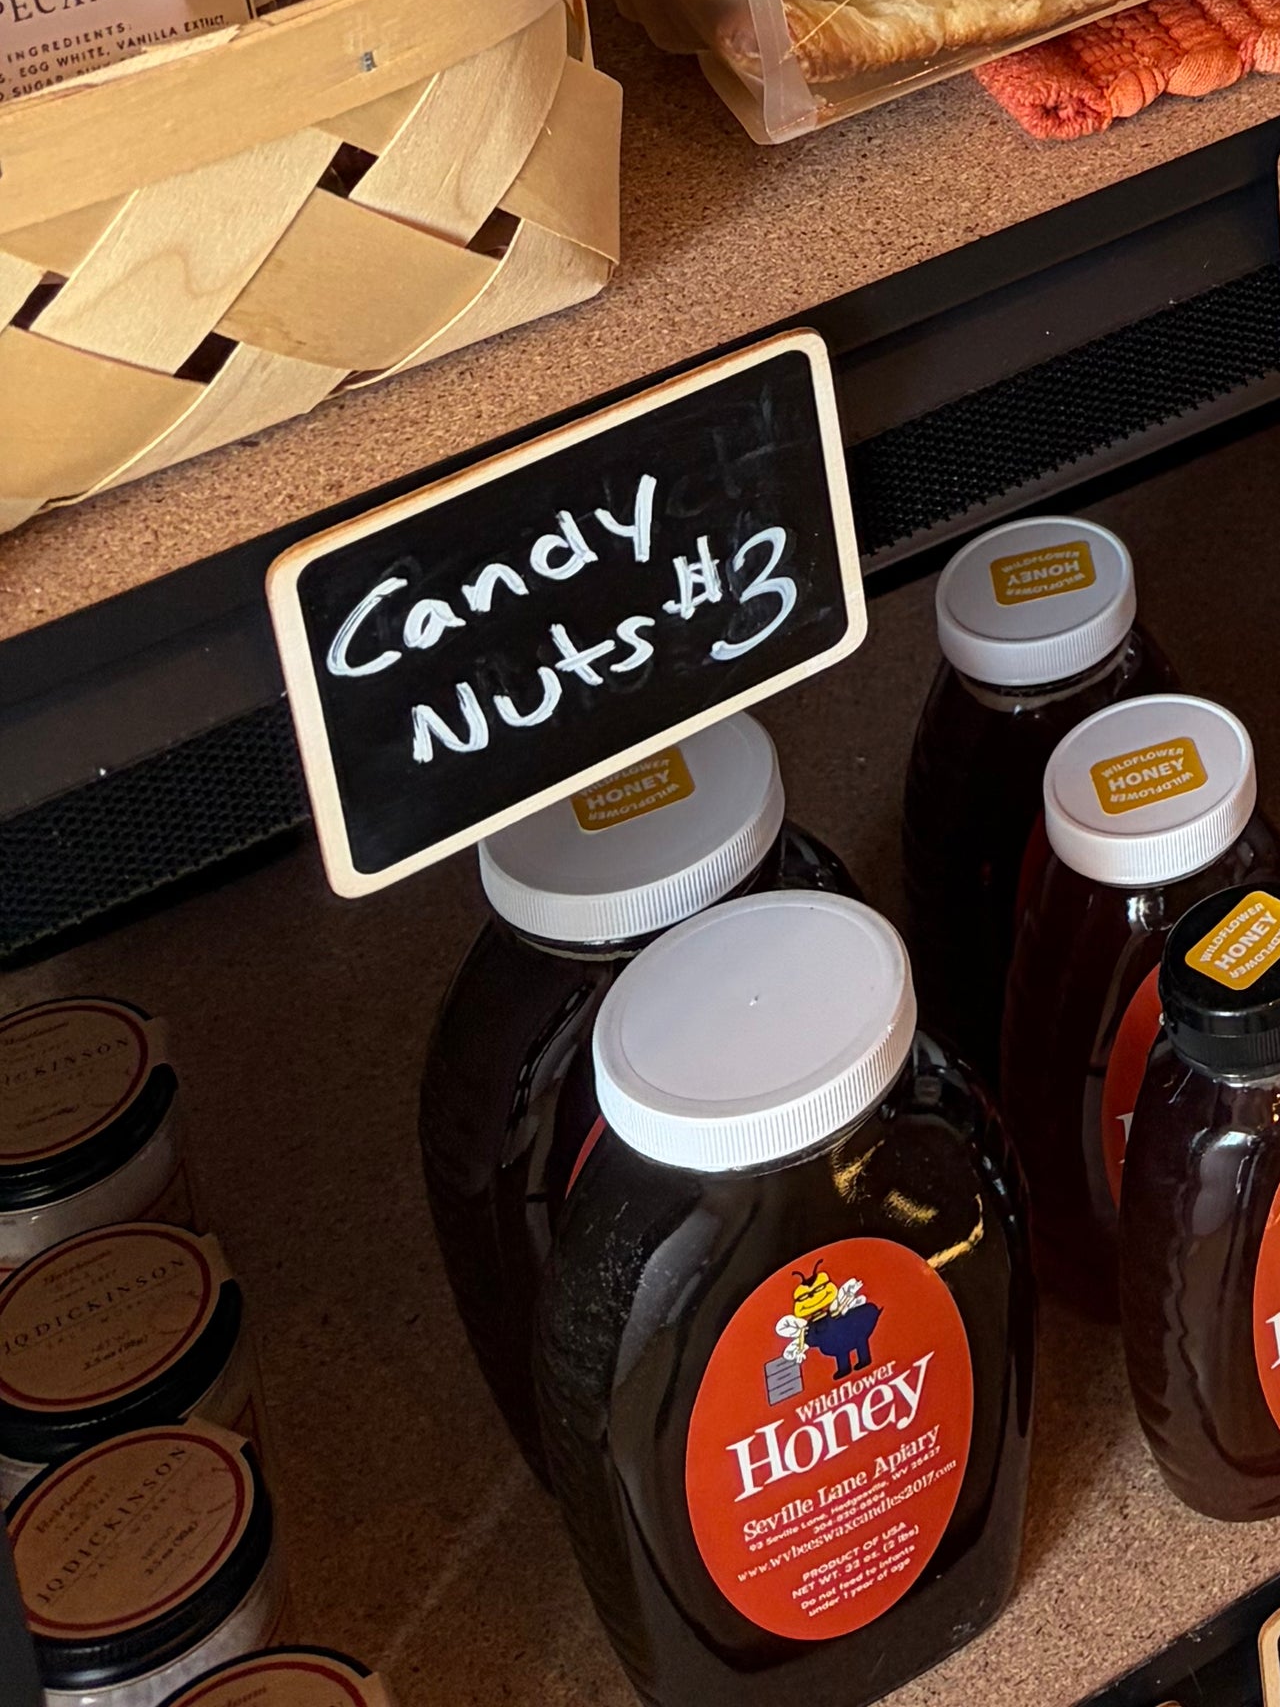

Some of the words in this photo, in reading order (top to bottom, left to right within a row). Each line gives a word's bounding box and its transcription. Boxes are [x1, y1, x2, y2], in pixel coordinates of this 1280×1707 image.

[325, 473, 657, 677] Candy
[409, 614, 658, 765] Nuts
[662, 525, 799, 663] $3
[1100, 745, 1185, 779] WILDFLOWER
[1108, 757, 1186, 793] HONEY
[1213, 909, 1279, 974] HONEY
[795, 1360, 897, 1423] Wildflower
[725, 1351, 936, 1503] Honey
[742, 1495, 815, 1542] Seville
[817, 1470, 868, 1508] Lane
[872, 1424, 941, 1480] Apiary
[801, 1544, 861, 1582] PRODUCT
[863, 1537, 879, 1553] OF
[881, 1521, 908, 1540] USA
